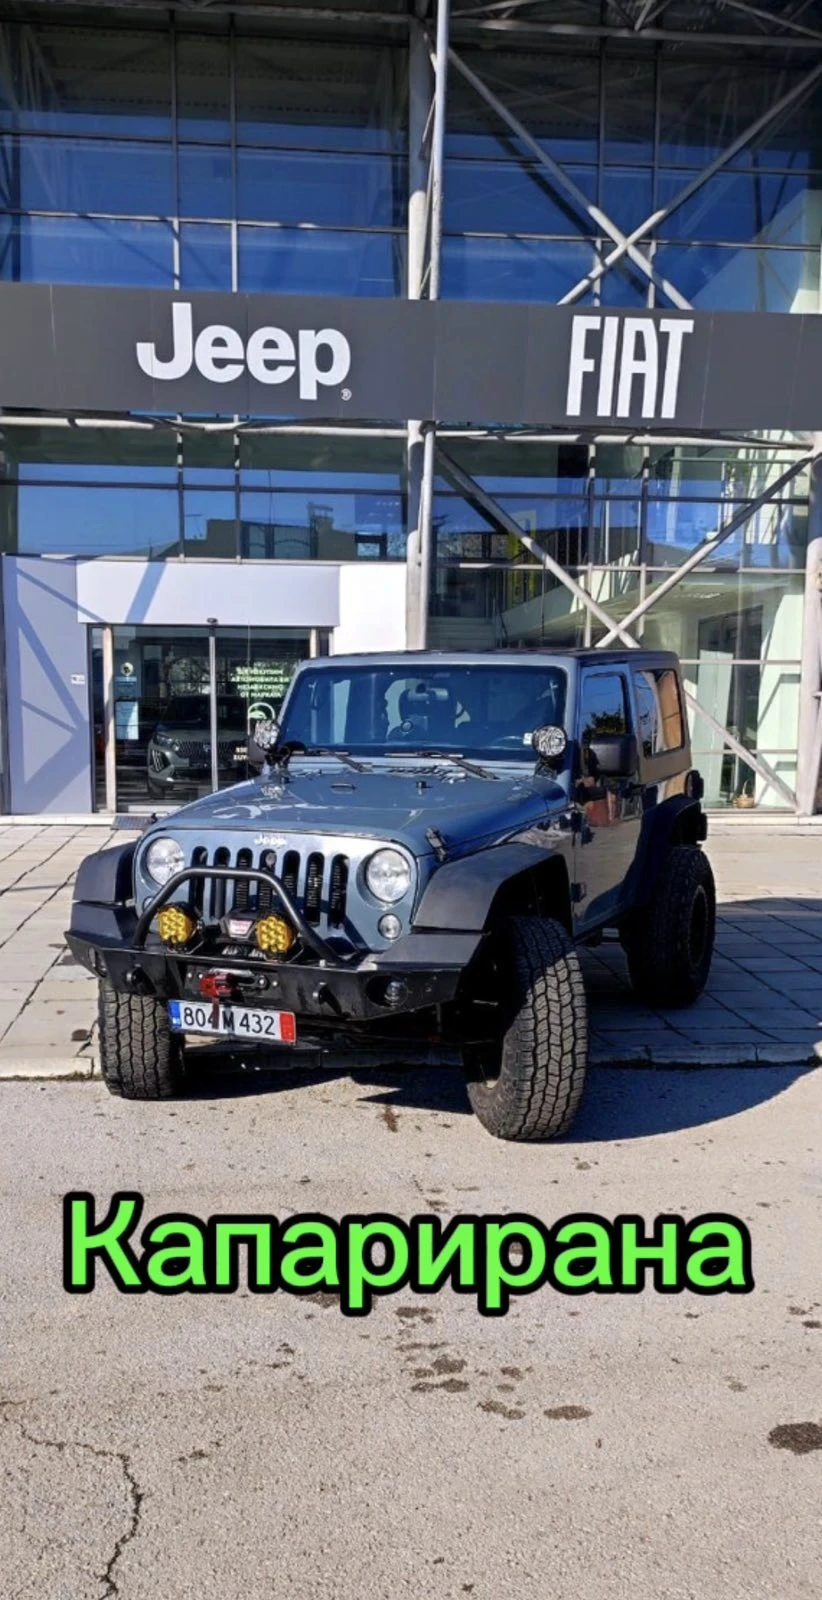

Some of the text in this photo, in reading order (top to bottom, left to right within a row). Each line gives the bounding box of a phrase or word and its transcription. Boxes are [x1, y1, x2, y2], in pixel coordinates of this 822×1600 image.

[136, 302, 351, 400] Jeep
[566, 315, 695, 418] FIAT
[253, 832, 288, 849] Jeep
[239, 1012, 276, 1036] 432
